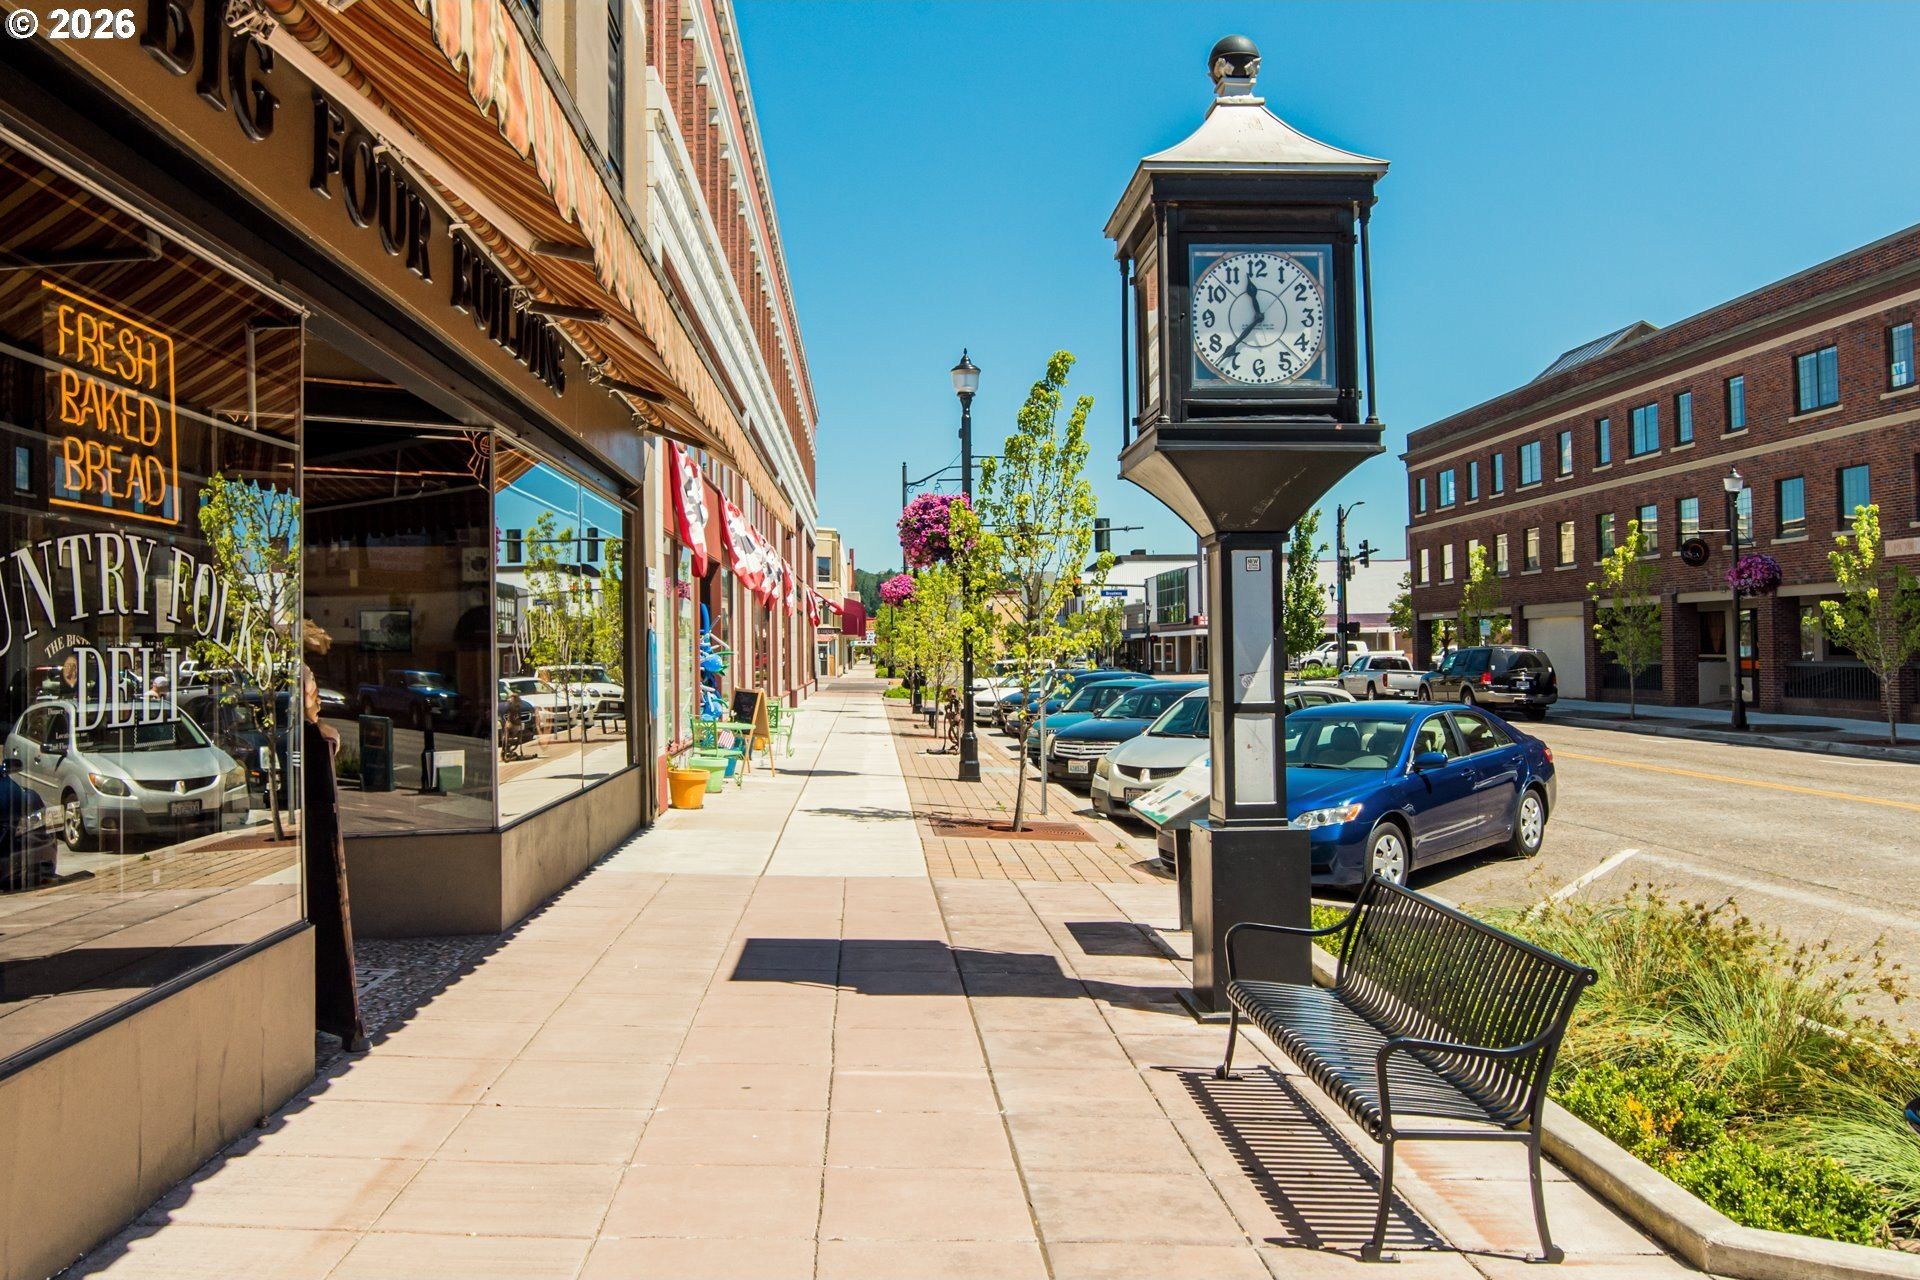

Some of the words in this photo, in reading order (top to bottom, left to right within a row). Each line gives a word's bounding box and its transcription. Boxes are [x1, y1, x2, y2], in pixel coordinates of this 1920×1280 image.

[309, 92, 434, 285] FOUR
[1225, 266, 1240, 285] 11
[1248, 259, 1268, 278] 12
[1278, 266, 1285, 285] 1
[1207, 285, 1227, 304] 10
[1294, 283, 1308, 302] 2
[1202, 308, 1216, 328] 9
[1301, 308, 1315, 328] 3
[58, 304, 157, 389] FRESH
[1209, 333, 1223, 353] 8
[1294, 332, 1310, 353] 4
[1230, 351, 1241, 371] 7
[1252, 358, 1266, 378] 6
[1278, 351, 1292, 371] 5
[60, 367, 161, 446] BAKED
[63, 436, 166, 505] BREAD
[167, 546, 279, 691] FOLKS
[44, 636, 65, 659] THE
[73, 647, 181, 731] DELI
